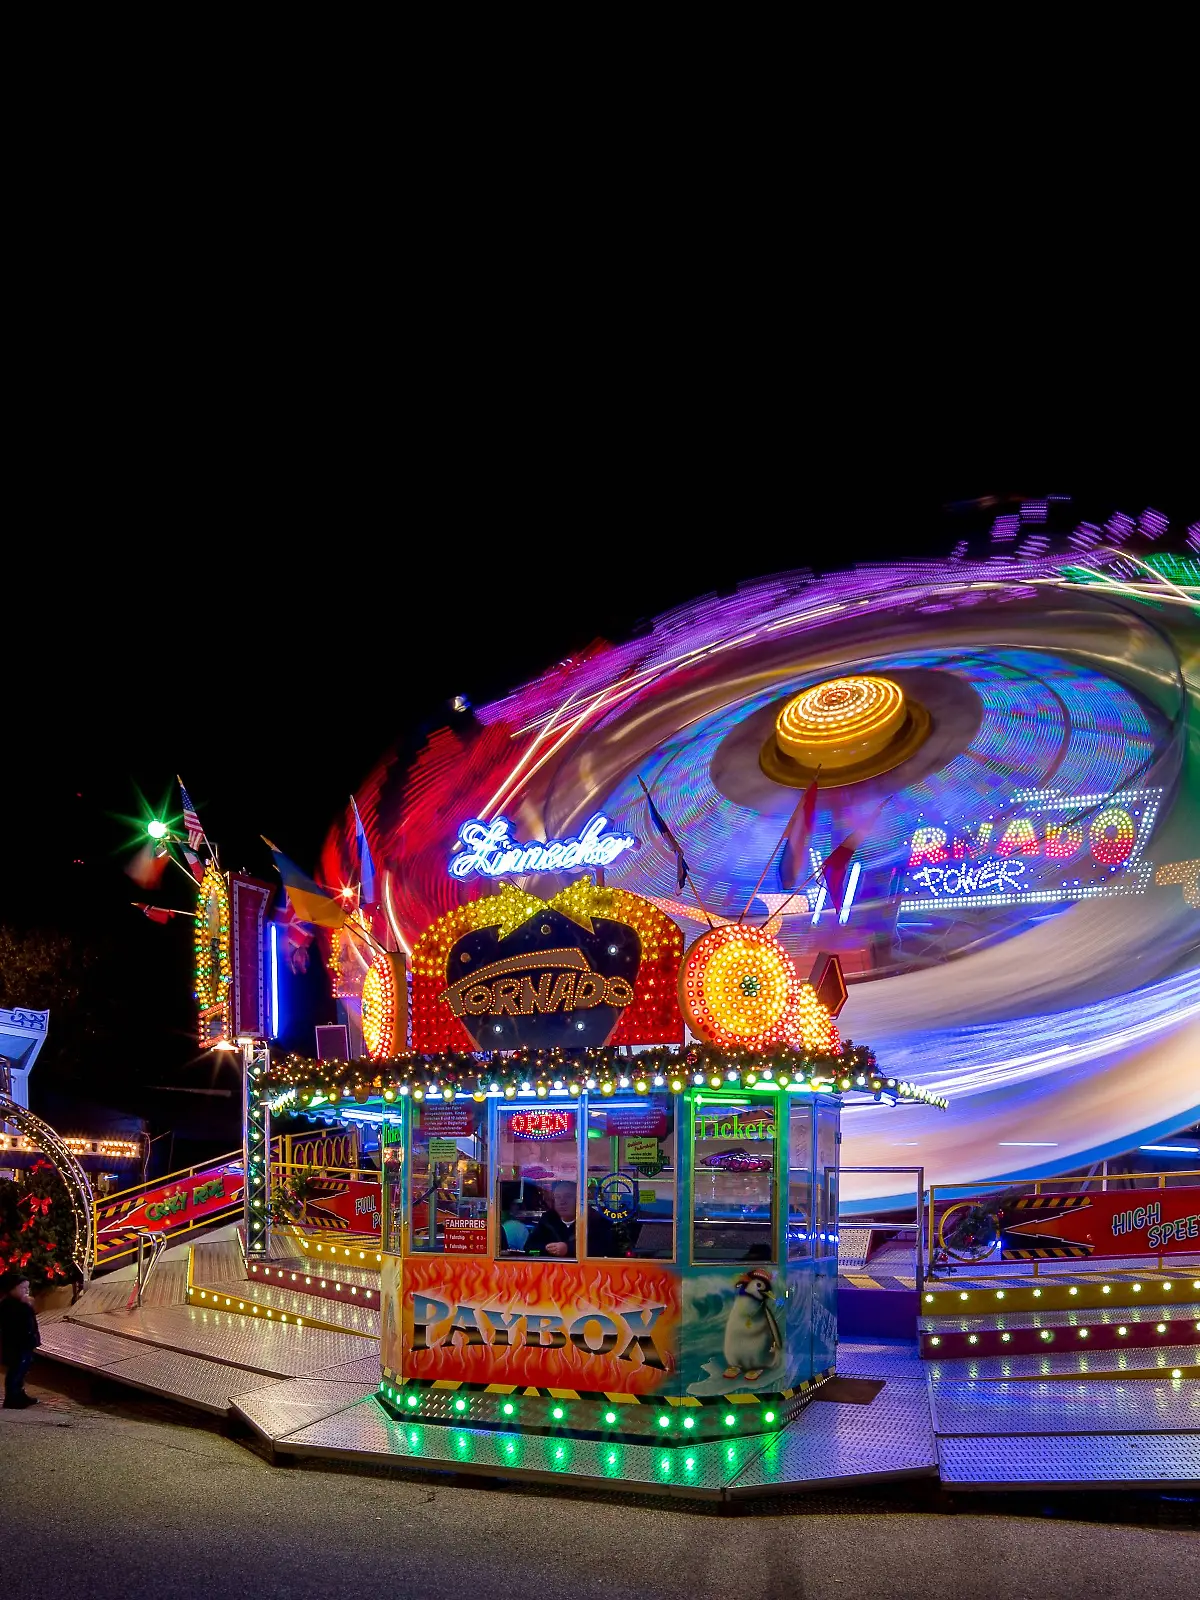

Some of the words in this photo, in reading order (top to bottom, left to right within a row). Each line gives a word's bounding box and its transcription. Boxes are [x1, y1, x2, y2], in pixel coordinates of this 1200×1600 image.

[913, 859, 1026, 896] POWER
[438, 947, 634, 1018] TORNADO
[512, 1112, 569, 1131] OPEN
[698, 1115, 777, 1139] Tickets
[145, 1190, 188, 1221] CRAZY
[193, 1176, 225, 1205] RIDE
[355, 1194, 377, 1216] FULL
[445, 1219, 486, 1229] FAHRPREIS
[1112, 1201, 1161, 1236] HIGH
[1147, 1214, 1200, 1249] SPEE
[410, 1293, 670, 1372] PAYBOX
